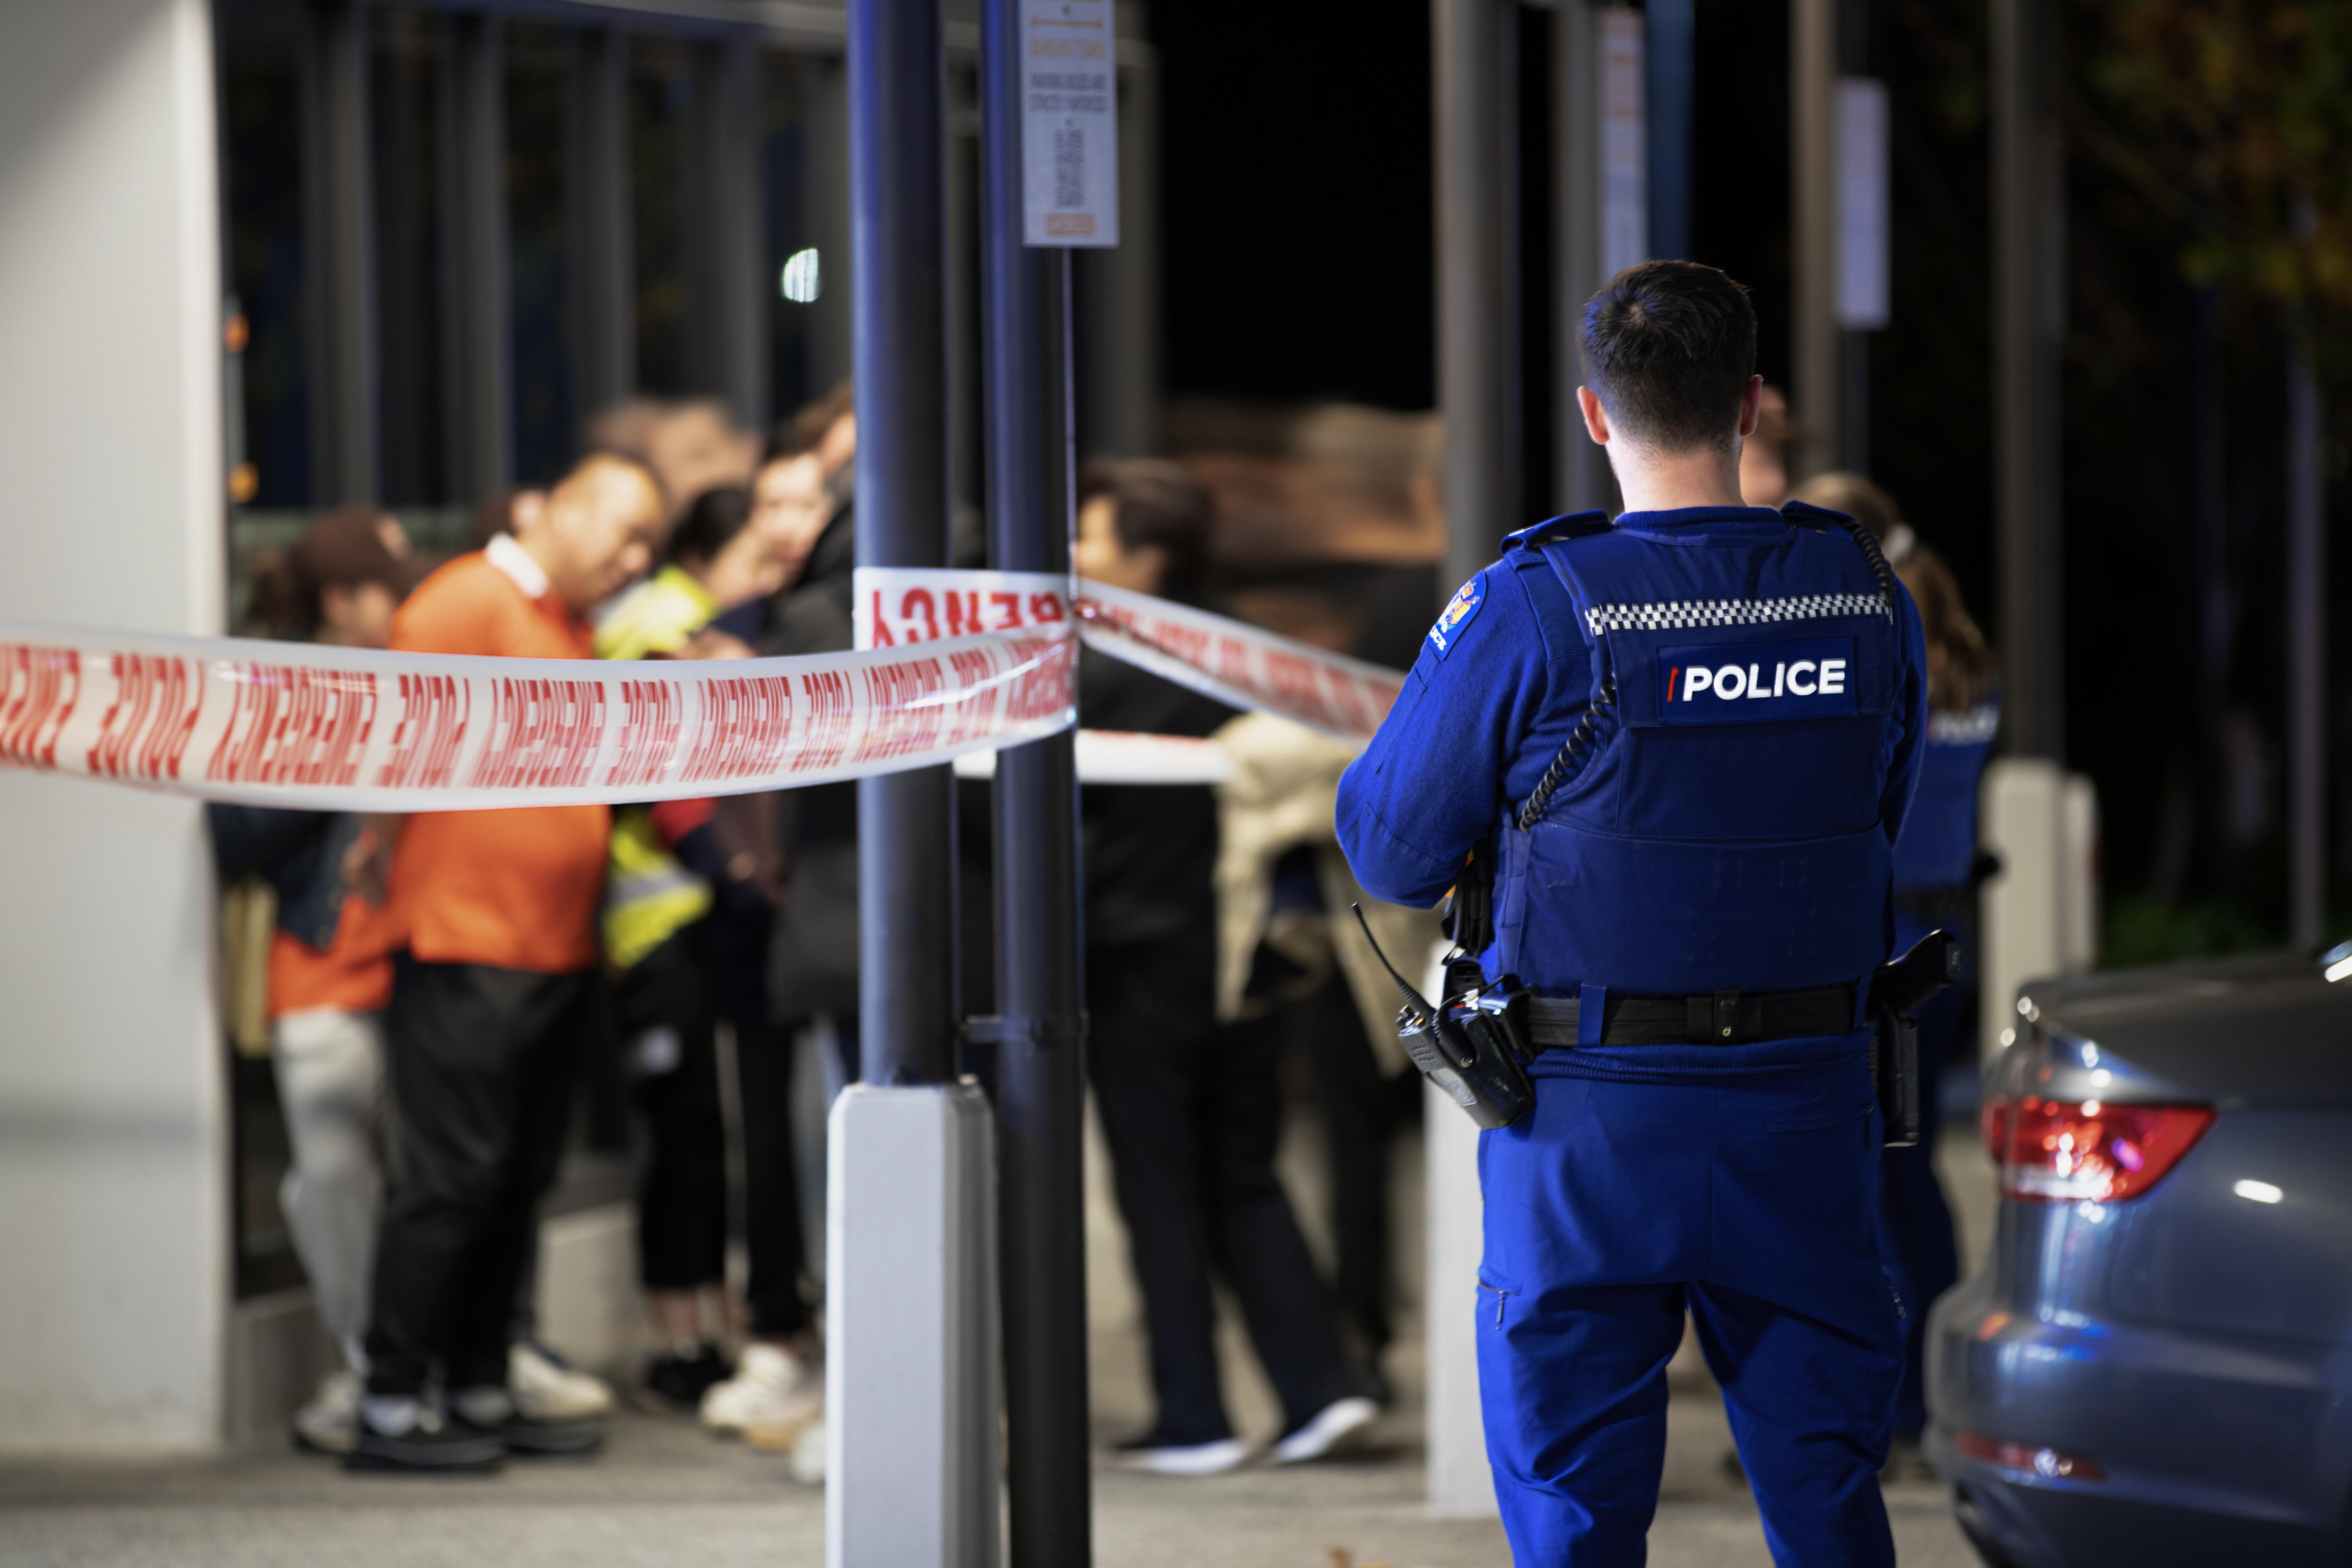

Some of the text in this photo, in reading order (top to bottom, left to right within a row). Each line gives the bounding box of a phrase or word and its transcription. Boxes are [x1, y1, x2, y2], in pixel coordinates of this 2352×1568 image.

[872, 587, 1063, 649] GENCY
[86, 653, 206, 781] POLICE
[205, 662, 378, 786] EMERGENCY
[373, 674, 470, 788] POLICE
[1682, 658, 1847, 701] POLICE
